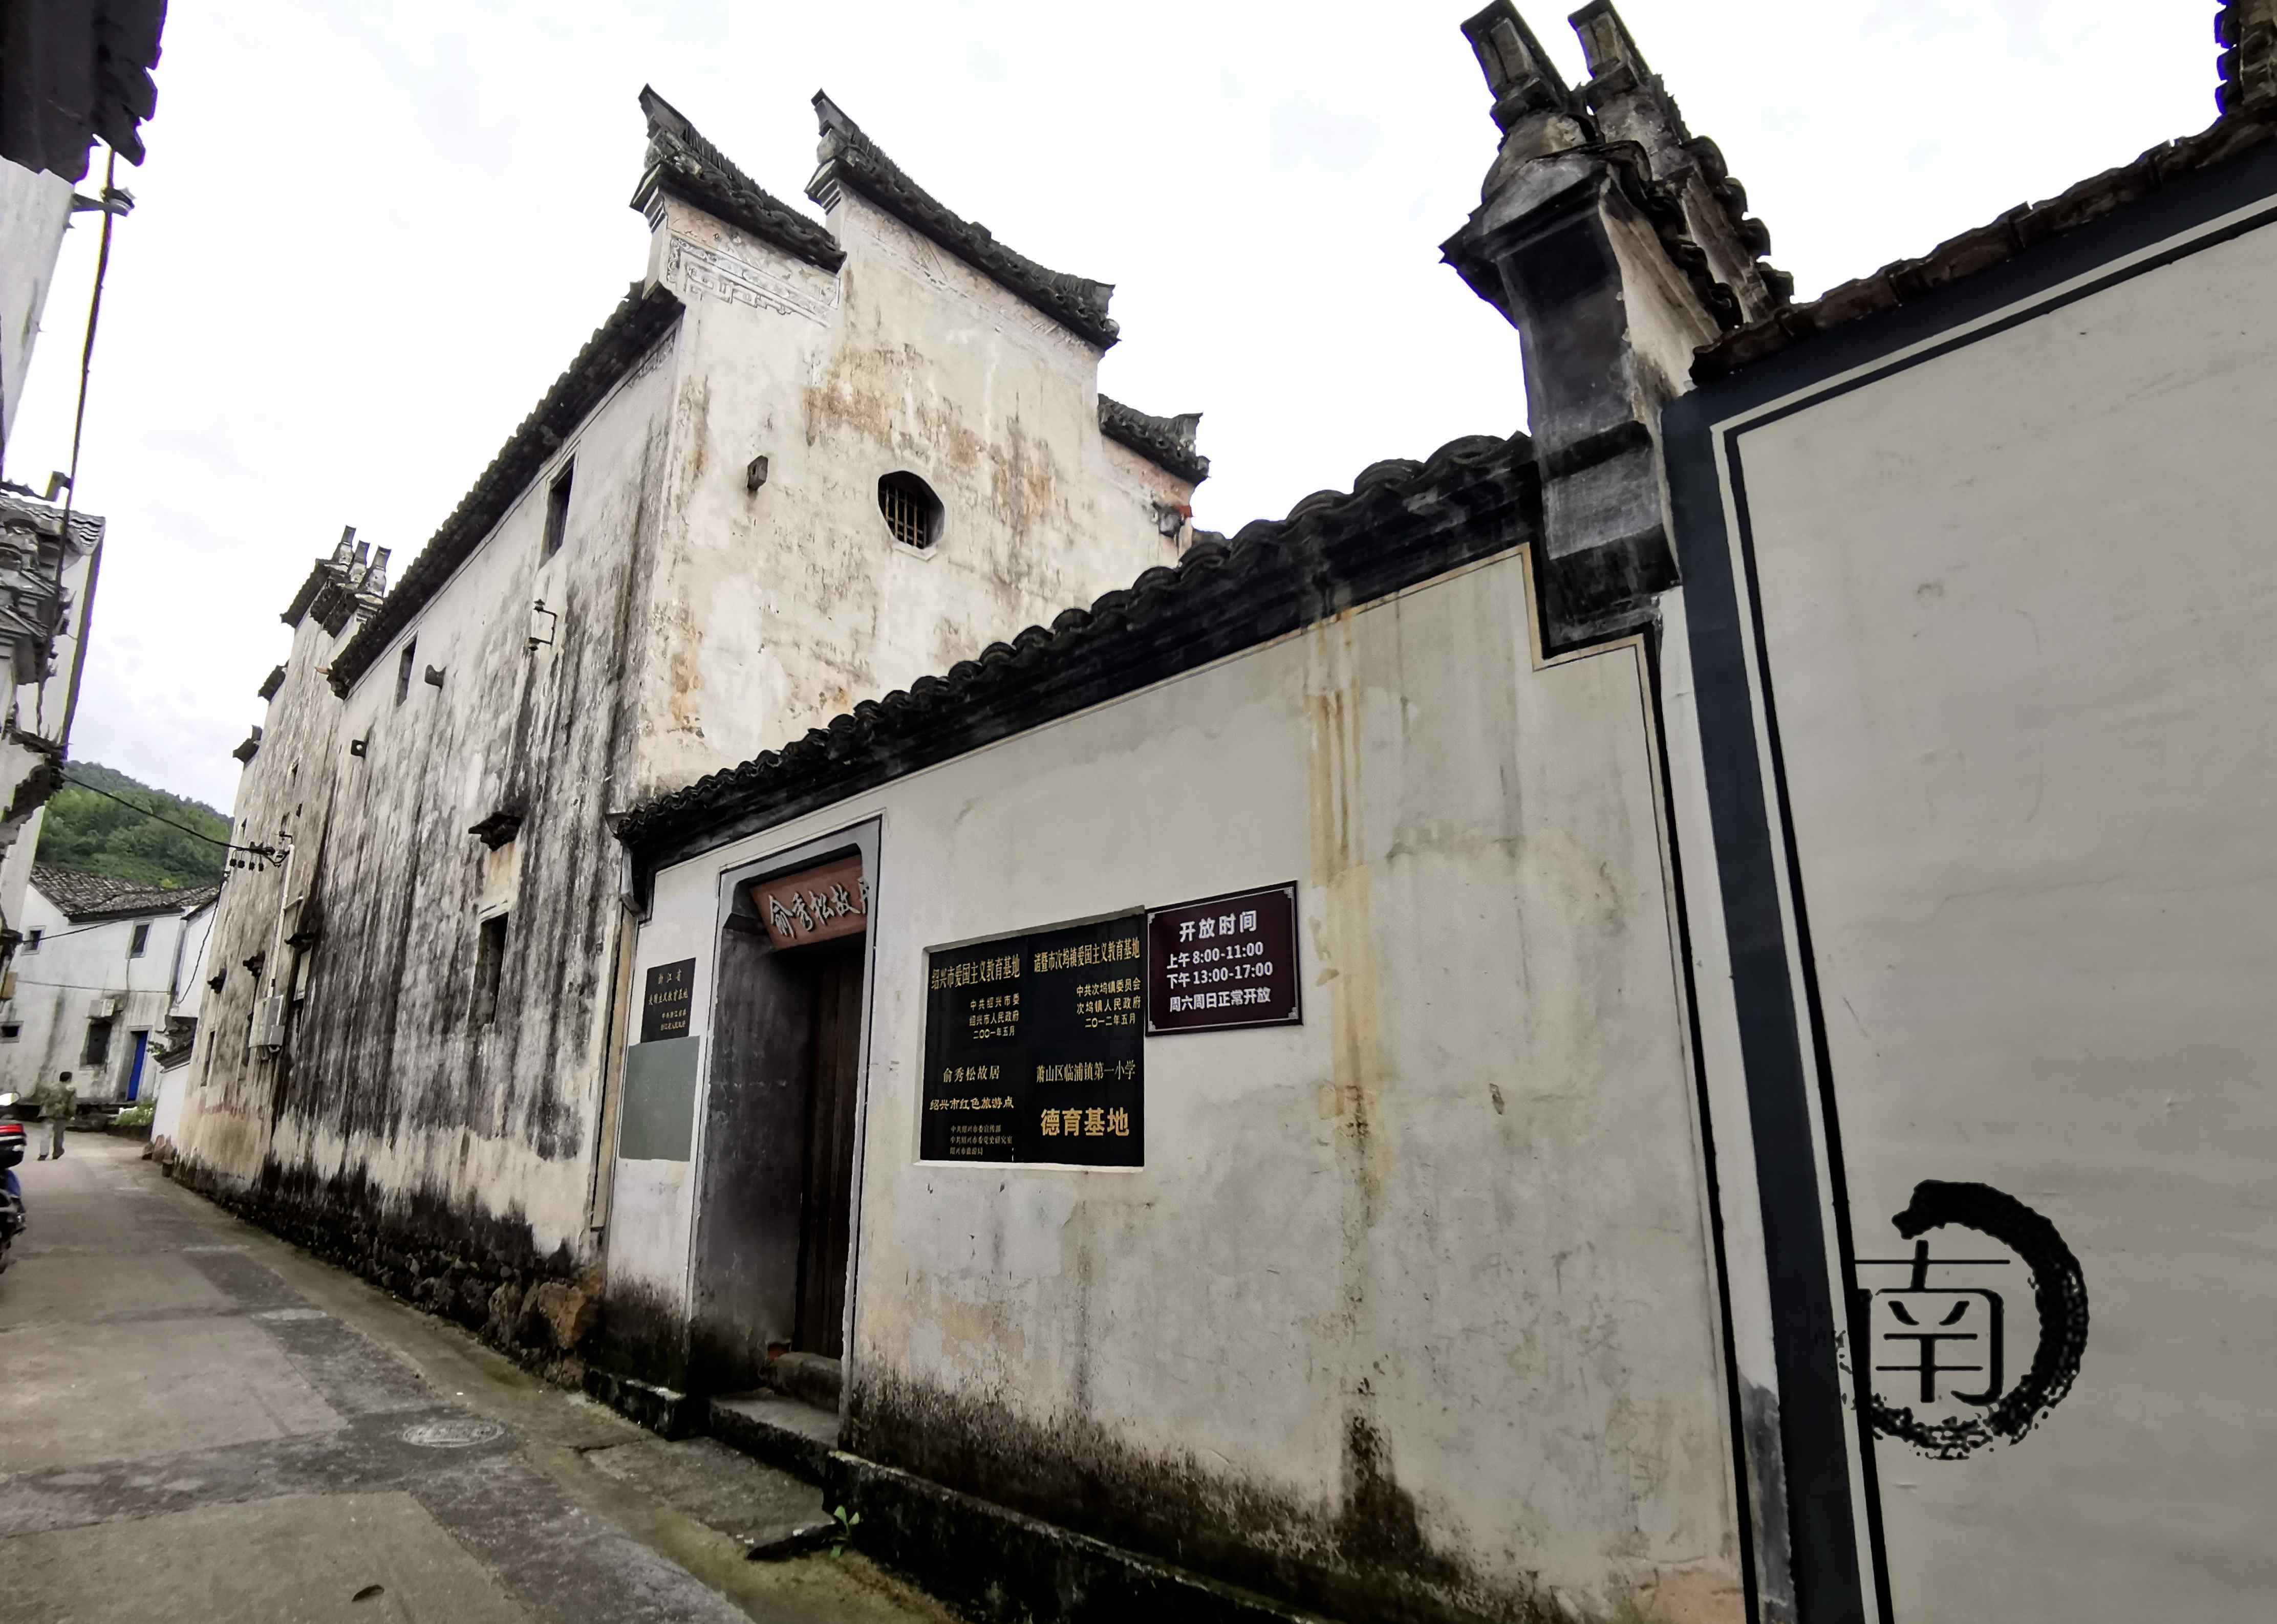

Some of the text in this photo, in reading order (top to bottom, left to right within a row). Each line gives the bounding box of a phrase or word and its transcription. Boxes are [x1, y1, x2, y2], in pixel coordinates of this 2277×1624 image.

[1179, 910, 1257, 942] 开放时间
[1034, 937, 1140, 972] 诸暨市次坞镇爱国主义教育基地
[931, 953, 1020, 990] 绍兴市爱国主义教育基地
[1076, 977, 1141, 998] 中共次坞镇委员会
[970, 992, 1020, 1011] 中共绍兴市委
[1077, 995, 1141, 1015] 次坞镇人民政府
[1169, 986, 1271, 1012] 周六周日正常开放
[969, 1009, 1019, 1026] 绍兴市人民政府
[943, 1065, 1000, 1083] 俞秀松故居
[1036, 1059, 1136, 1083] 萧山区临浦镇第一小学
[929, 1096, 1014, 1110] 绍兴市红色旅游点
[1041, 1107, 1130, 1136] 德育基地
